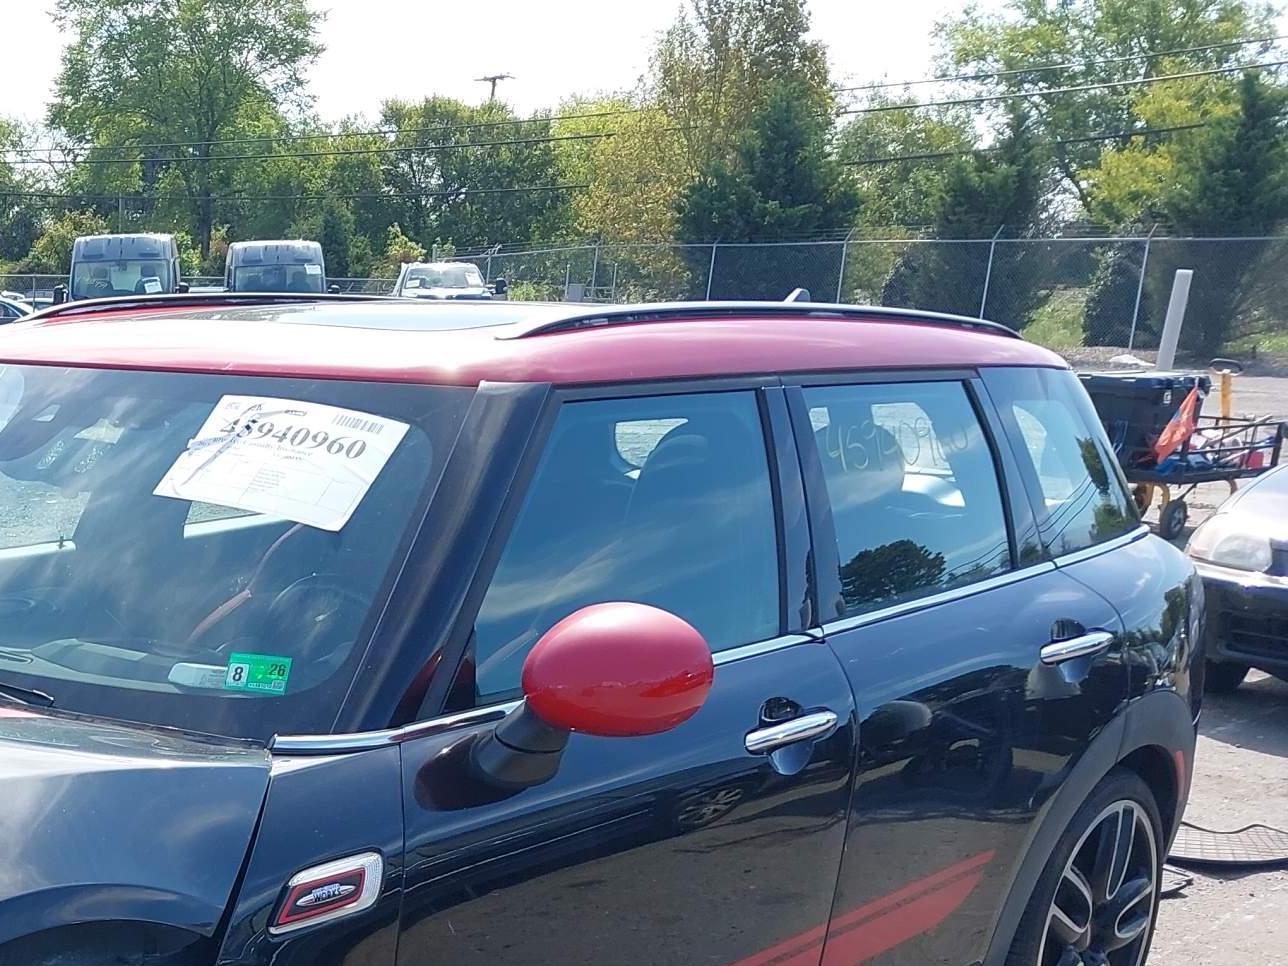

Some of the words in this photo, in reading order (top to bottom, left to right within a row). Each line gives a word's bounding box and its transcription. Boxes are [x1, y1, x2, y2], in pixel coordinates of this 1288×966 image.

[219, 418, 368, 460] 45940960
[232, 666, 244, 682] 8
[268, 663, 287, 677] 26
